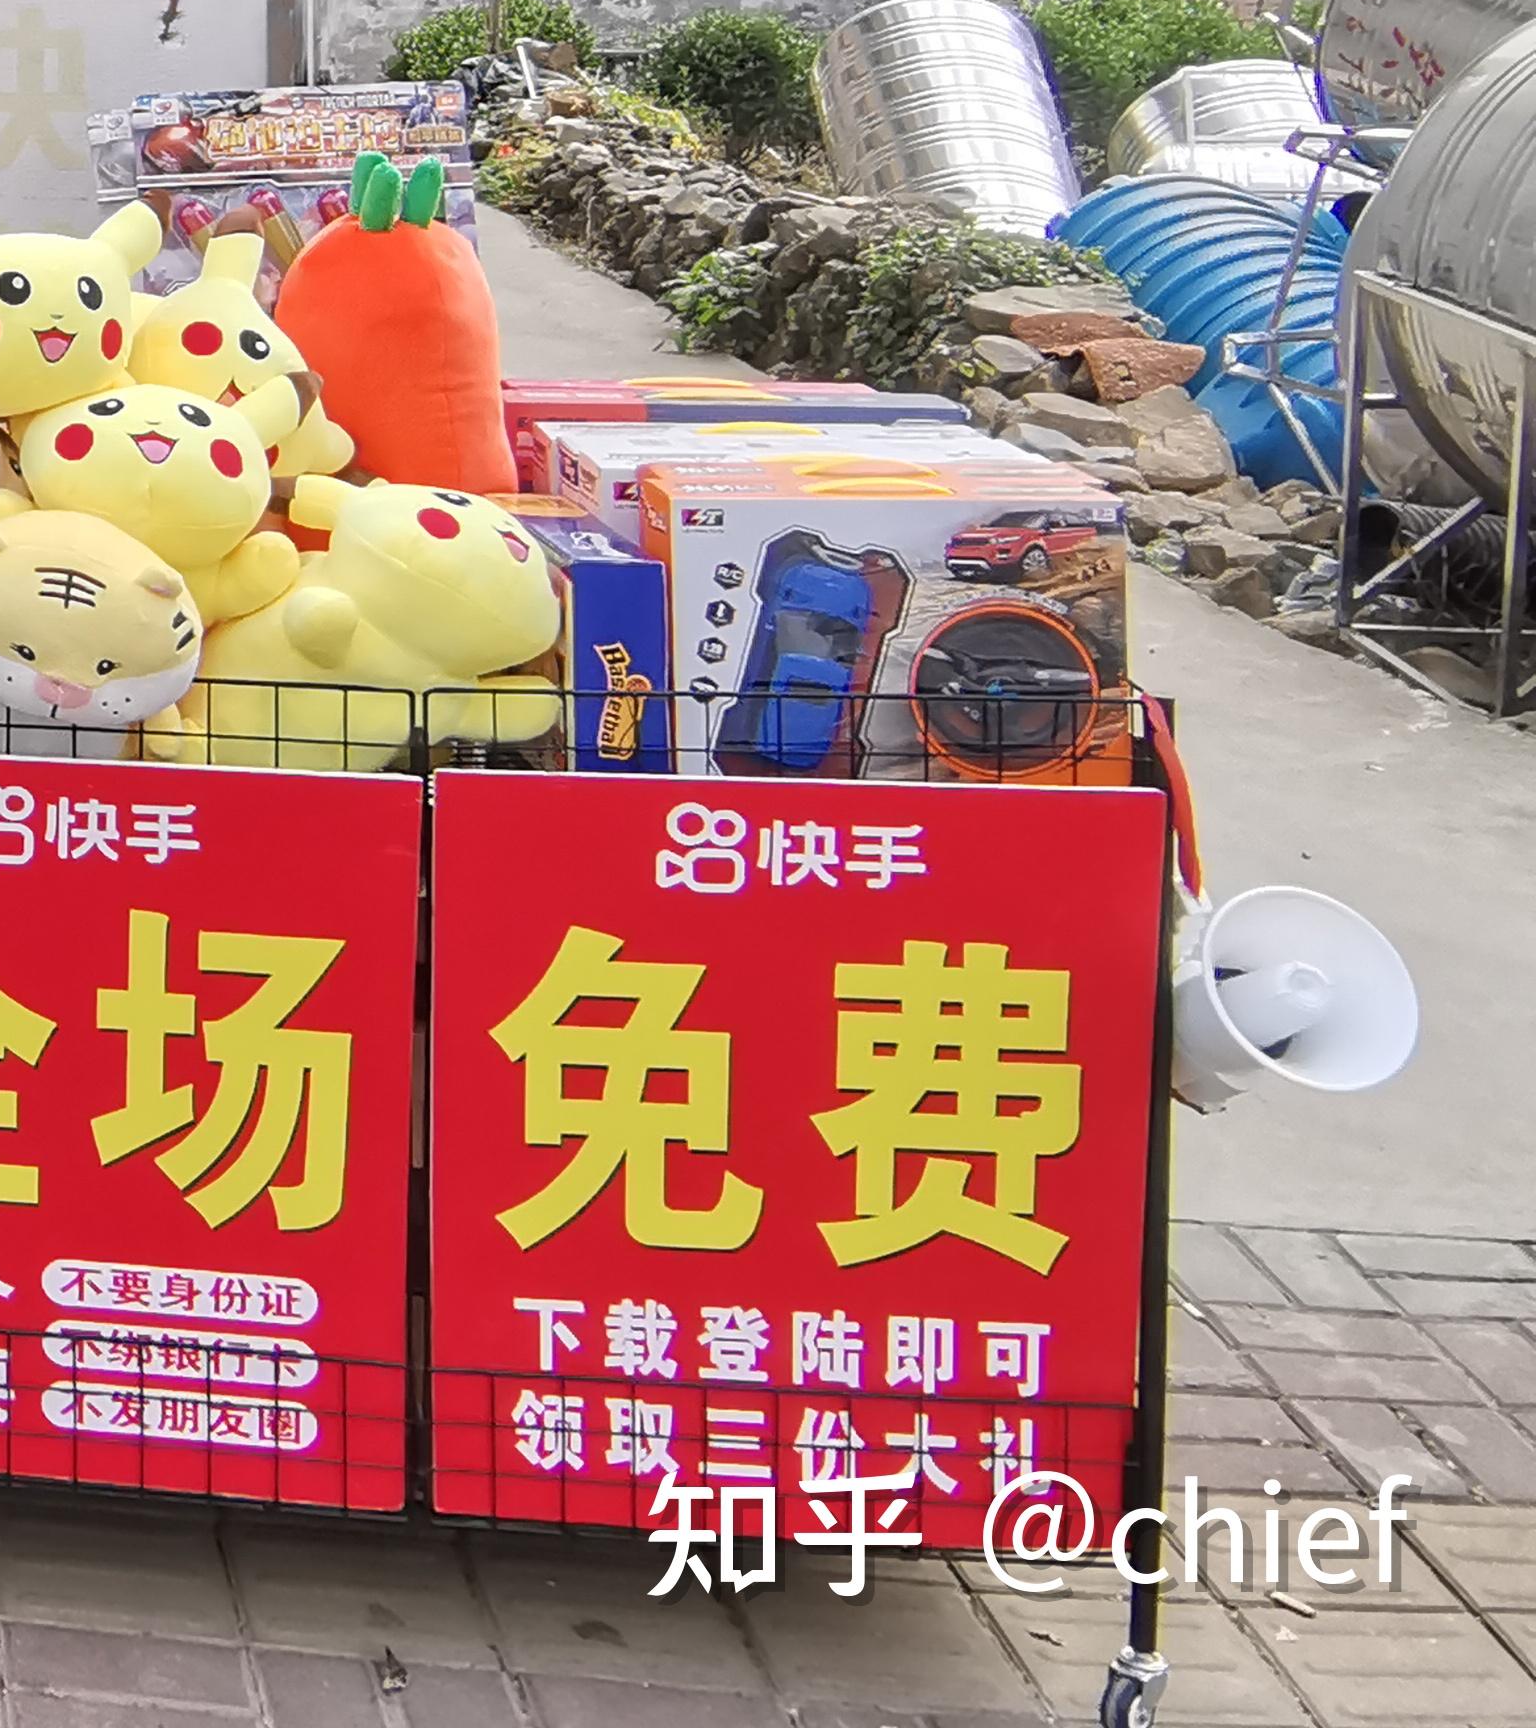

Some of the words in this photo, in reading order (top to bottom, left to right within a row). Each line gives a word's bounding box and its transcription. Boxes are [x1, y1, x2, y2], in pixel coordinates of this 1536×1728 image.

[46, 795, 201, 863] 快手
[758, 819, 927, 889] 快手
[489, 925, 1083, 1277] 免费
[60, 1266, 303, 1320] 不要身份证
[60, 1327, 302, 1380] 不绑银行卡
[513, 1296, 1052, 1399] 下载登陆即可
[60, 1389, 302, 1444] 不发朋友圈
[511, 1388, 1053, 1500] 领取三份大礼
